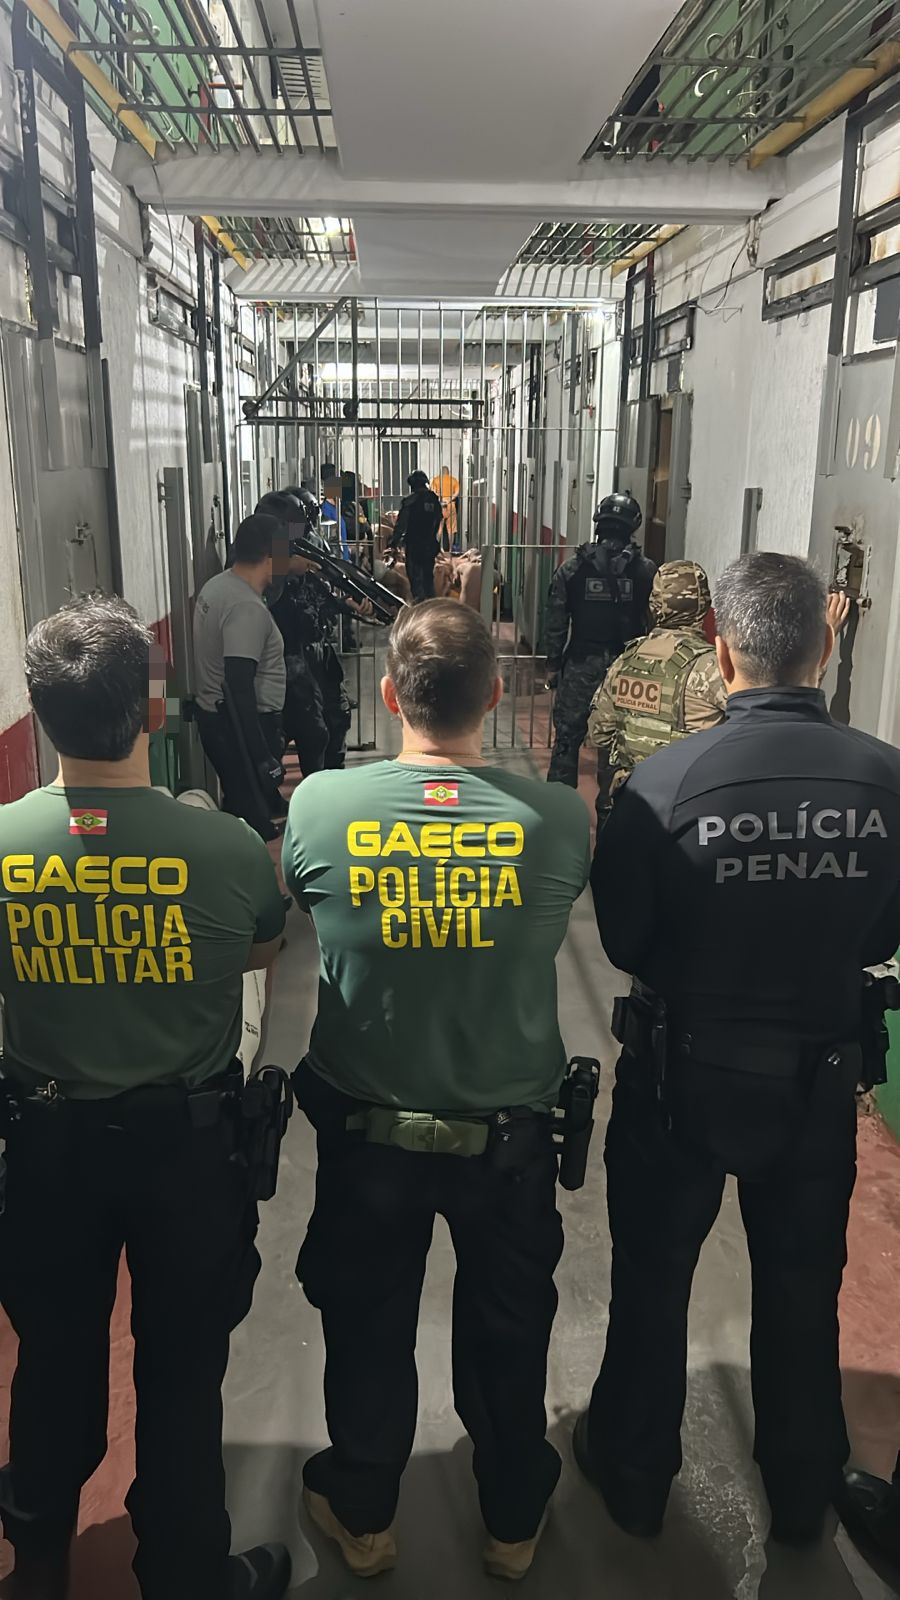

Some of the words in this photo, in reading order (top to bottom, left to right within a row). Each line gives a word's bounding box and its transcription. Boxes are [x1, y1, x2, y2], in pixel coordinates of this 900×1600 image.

[845, 413, 881, 471] 09
[618, 678, 658, 702] DOC
[347, 821, 524, 857] GAECO
[698, 801, 888, 846] POLÍCIA
[1, 855, 188, 895] GAECO
[349, 858, 523, 908] POLÍCIA
[715, 851, 869, 884] PENAL
[6, 894, 191, 947] POLÍCIA
[381, 907, 495, 949] CIVIL
[11, 945, 194, 984] MILITAR
